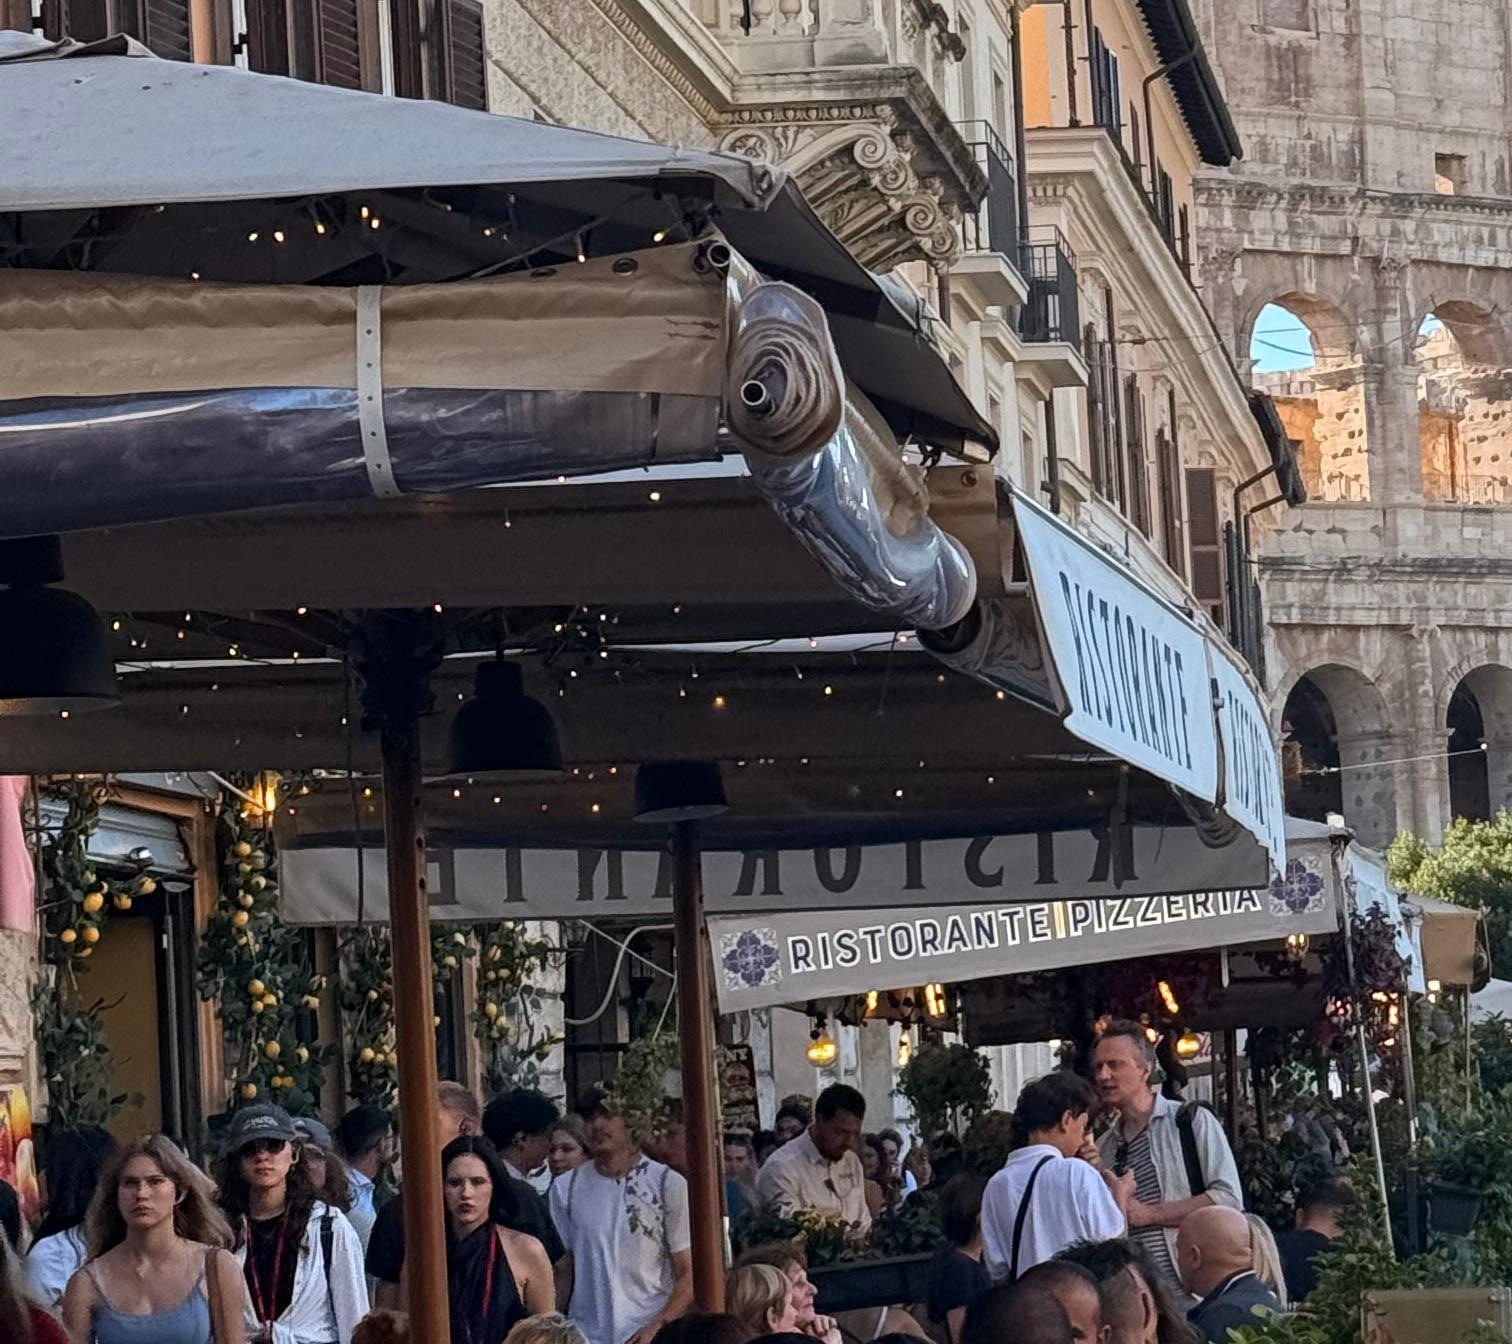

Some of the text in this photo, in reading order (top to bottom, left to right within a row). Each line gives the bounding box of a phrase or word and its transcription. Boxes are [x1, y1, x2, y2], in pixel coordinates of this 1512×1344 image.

[1058, 571, 1193, 771] RISTORANTE
[788, 889, 1262, 975] RISTORANTE PIZZERIA
